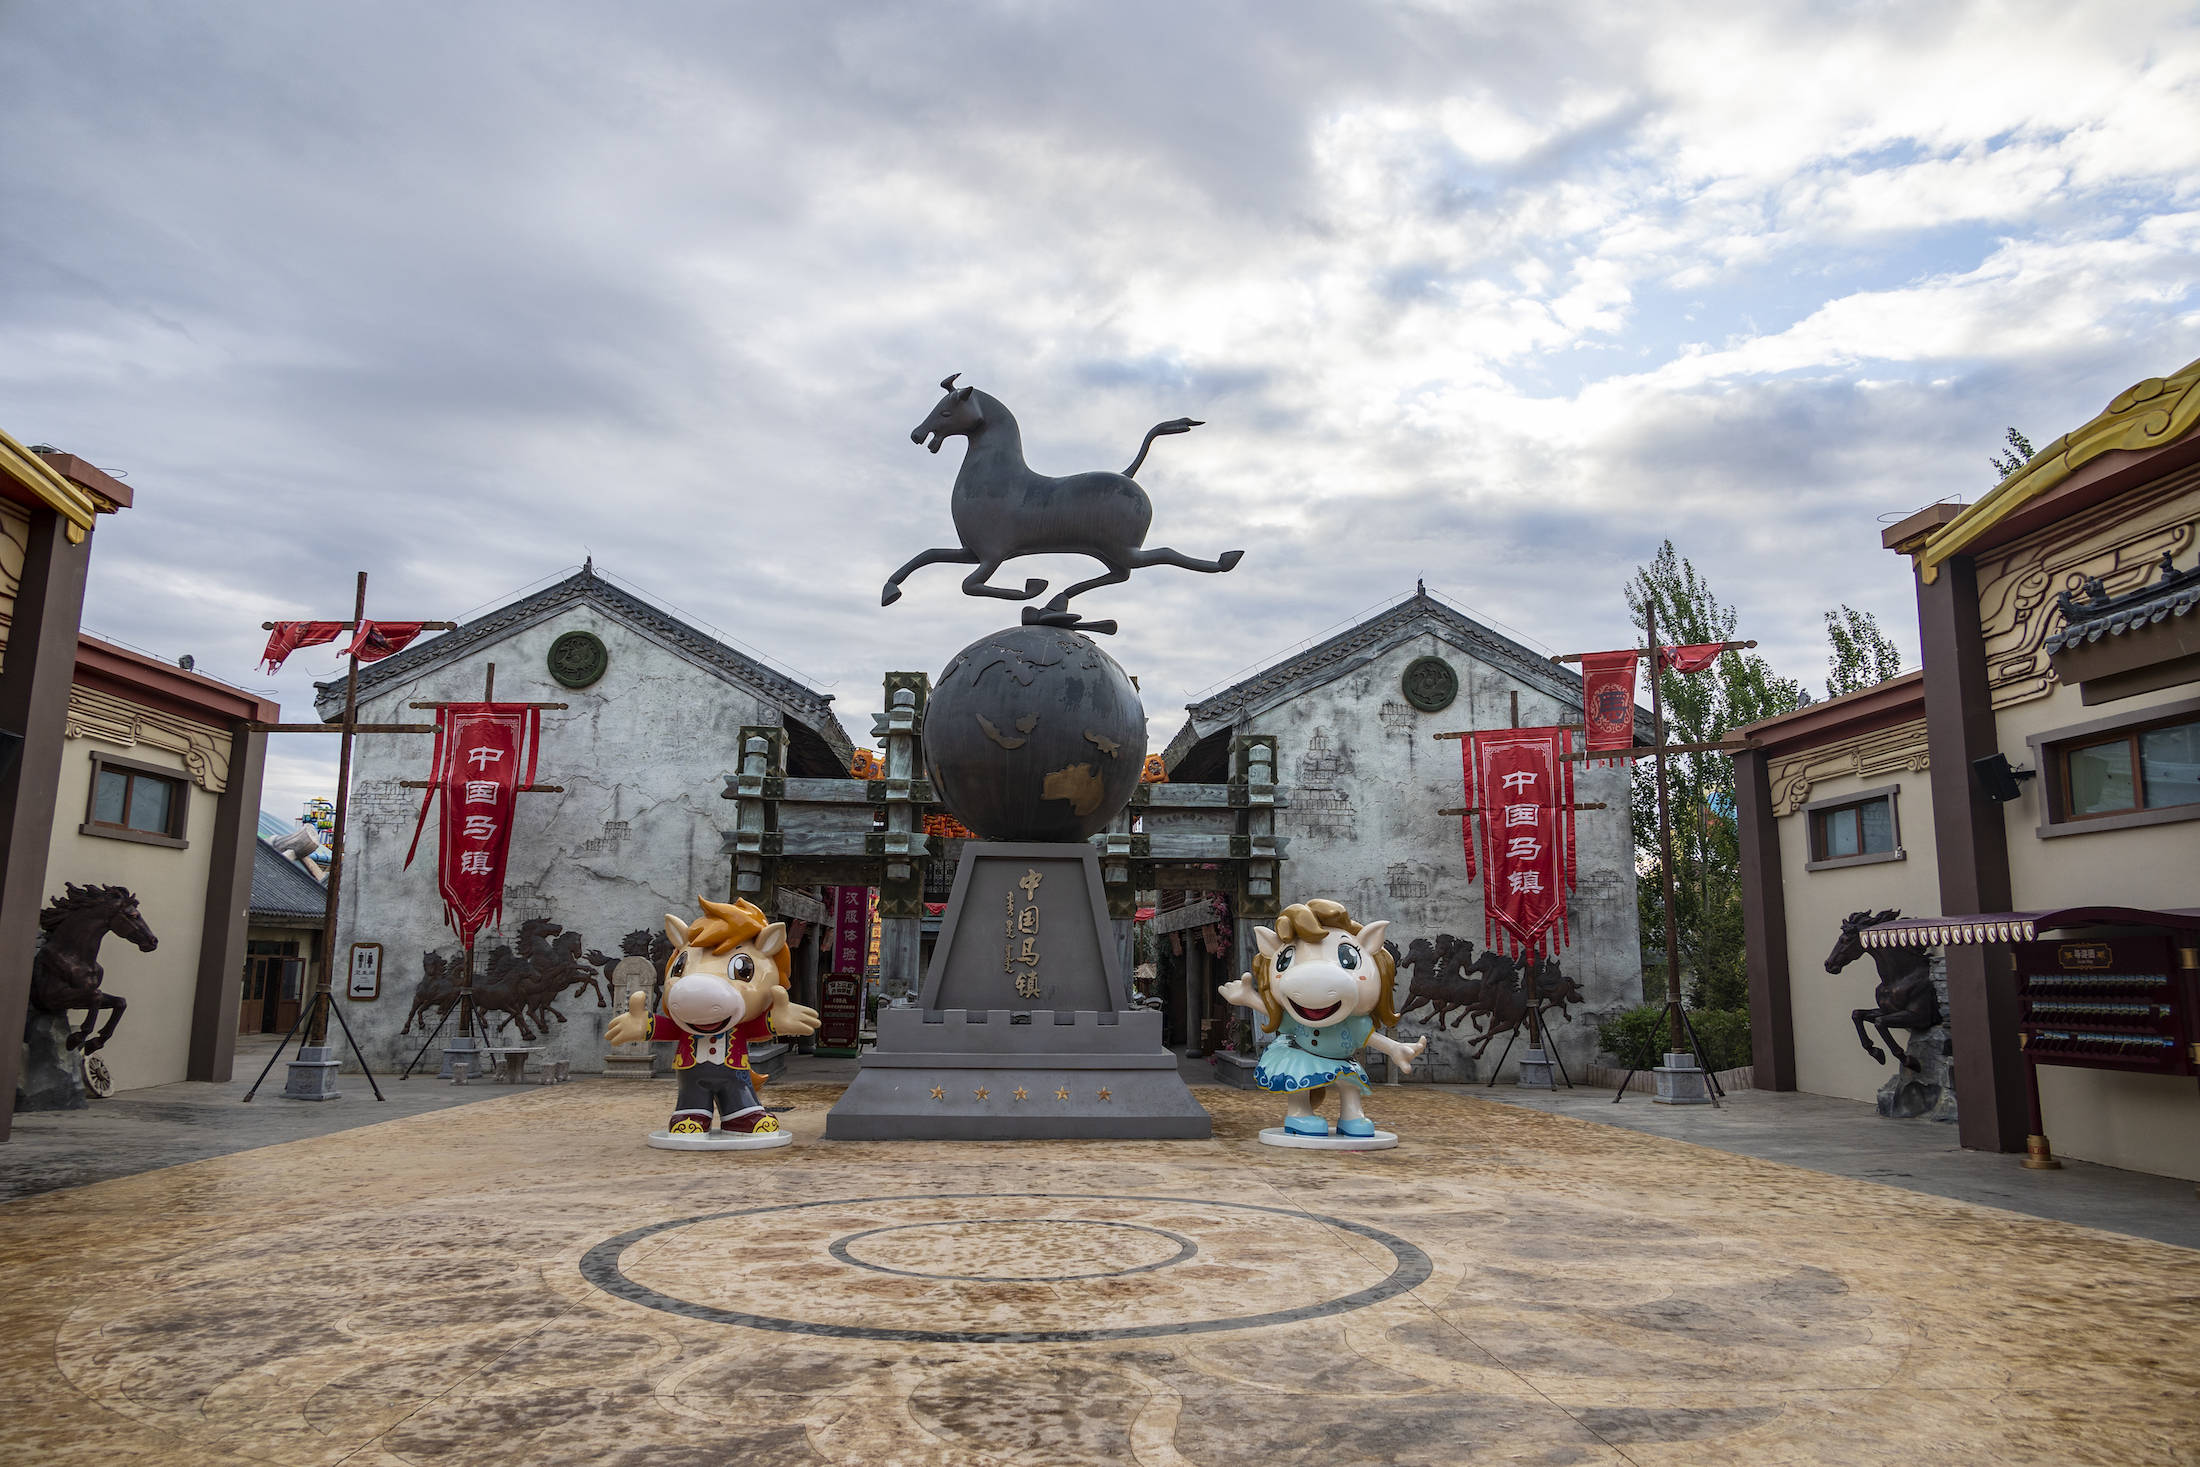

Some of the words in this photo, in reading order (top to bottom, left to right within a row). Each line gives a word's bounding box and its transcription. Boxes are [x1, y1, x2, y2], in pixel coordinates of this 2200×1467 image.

[461, 745, 505, 876] 中国马镇
[1502, 770, 1544, 896] 中国马镇
[1015, 868, 1043, 999] 中国马镇
